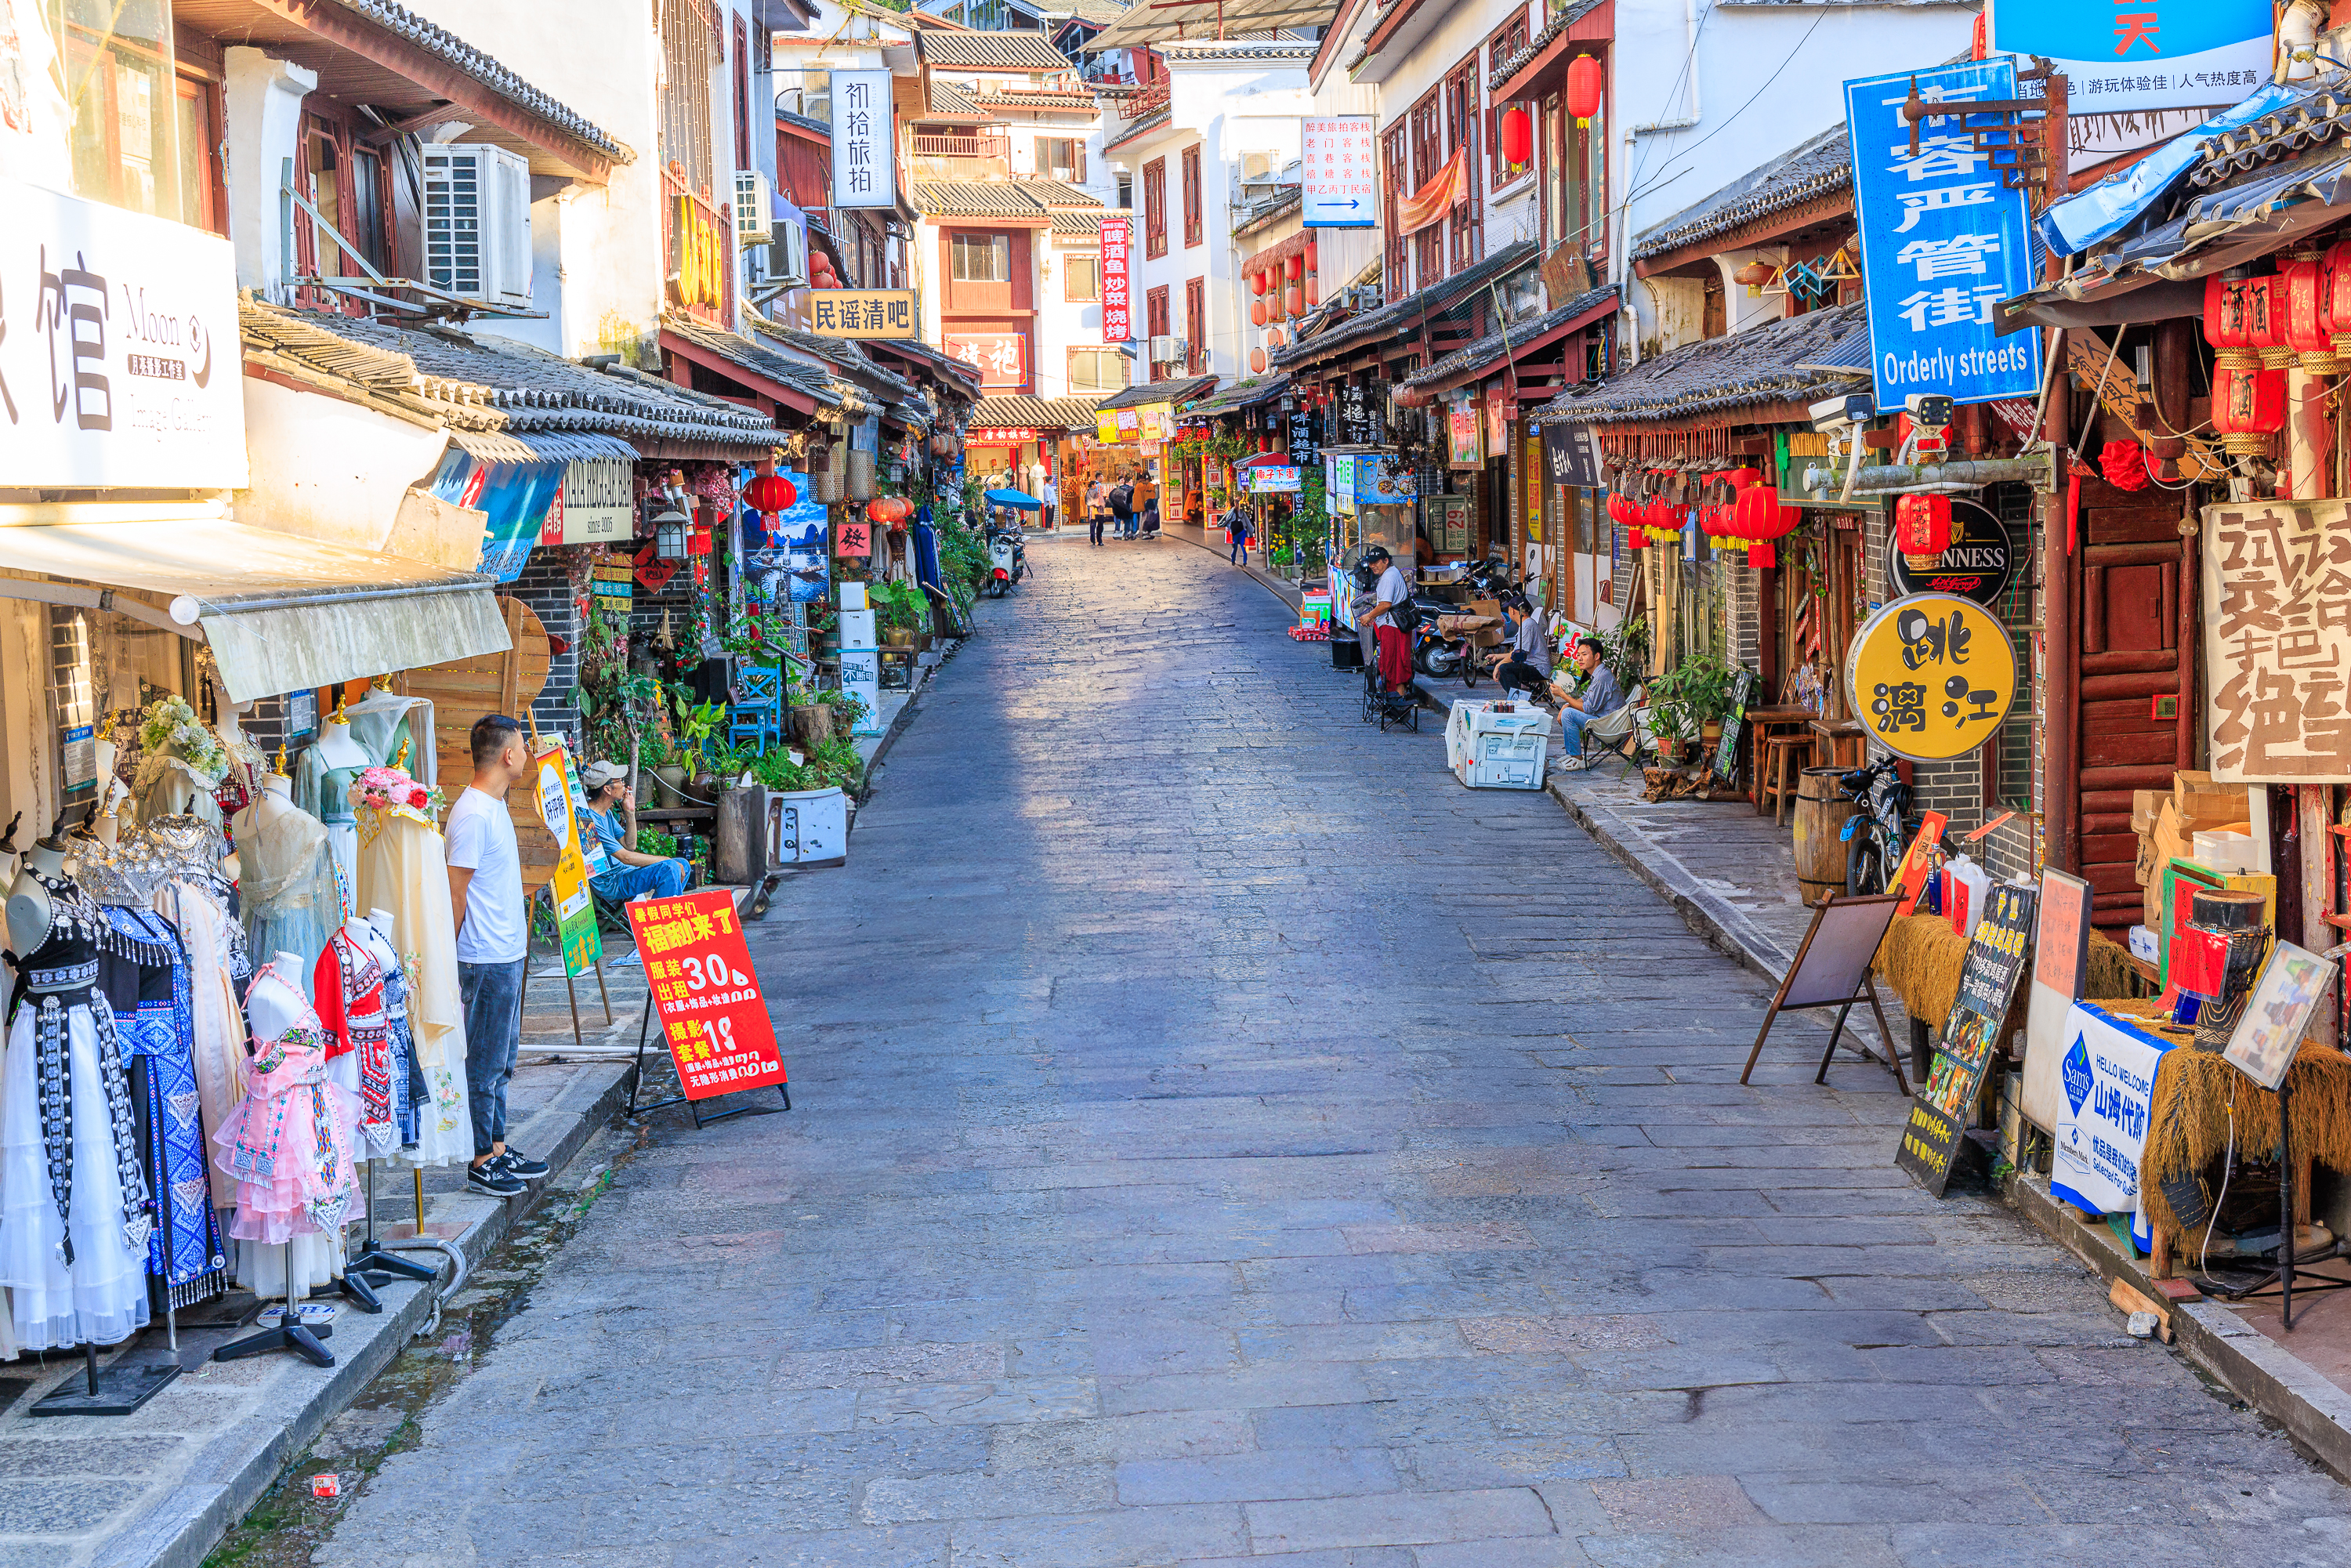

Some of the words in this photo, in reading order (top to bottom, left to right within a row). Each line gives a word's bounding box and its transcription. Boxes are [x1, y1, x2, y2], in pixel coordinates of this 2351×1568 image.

[2088, 74, 2168, 94] 游玩体验佳
[2179, 69, 2257, 89] 人气热度高
[846, 82, 871, 194] 初拾旅拍
[1306, 122, 1371, 132] 醉美旅拍客栈
[1306, 137, 1371, 148] 老门客栈
[1306, 153, 1371, 164] 喜巷客栈
[1307, 184, 1371, 194] 甲乙丙丁民宿
[1882, 85, 2008, 332] 市容严管街
[1103, 230, 1125, 273] 啤酒鱼
[1105, 277, 1126, 306] 炒菜
[123, 284, 180, 346] Moon
[816, 299, 910, 331] 民谣清吧
[1106, 310, 1127, 339] 烧烤
[1884, 347, 1954, 386] Orderly
[1959, 342, 2027, 378] streets
[1290, 412, 1313, 464] 啤酒超市
[618, 458, 632, 508] BAR
[1256, 468, 1295, 480] 椰子下蛋
[587, 516, 600, 534] since
[1940, 547, 2005, 568] NNESS
[844, 669, 873, 681] 不断电
[635, 901, 697, 923] 暑假同学们
[643, 907, 734, 954] 福利来了
[650, 959, 683, 980] 服装
[683, 954, 728, 990] 30
[657, 980, 690, 1001] 出租
[669, 1019, 704, 1041] 摄影
[676, 1040, 712, 1063] 套餐
[2064, 1059, 2090, 1091] Sam's
[2096, 1054, 2117, 1077] HELLO
[2119, 1066, 2150, 1096] WELCOME
[2070, 1085, 2084, 1097] CLUB
[2094, 1080, 2146, 1145] 山姆代购
[2060, 1140, 2078, 1158] Member's
[2093, 1157, 2114, 1183] Selected
[2114, 1171, 2123, 1189] For
